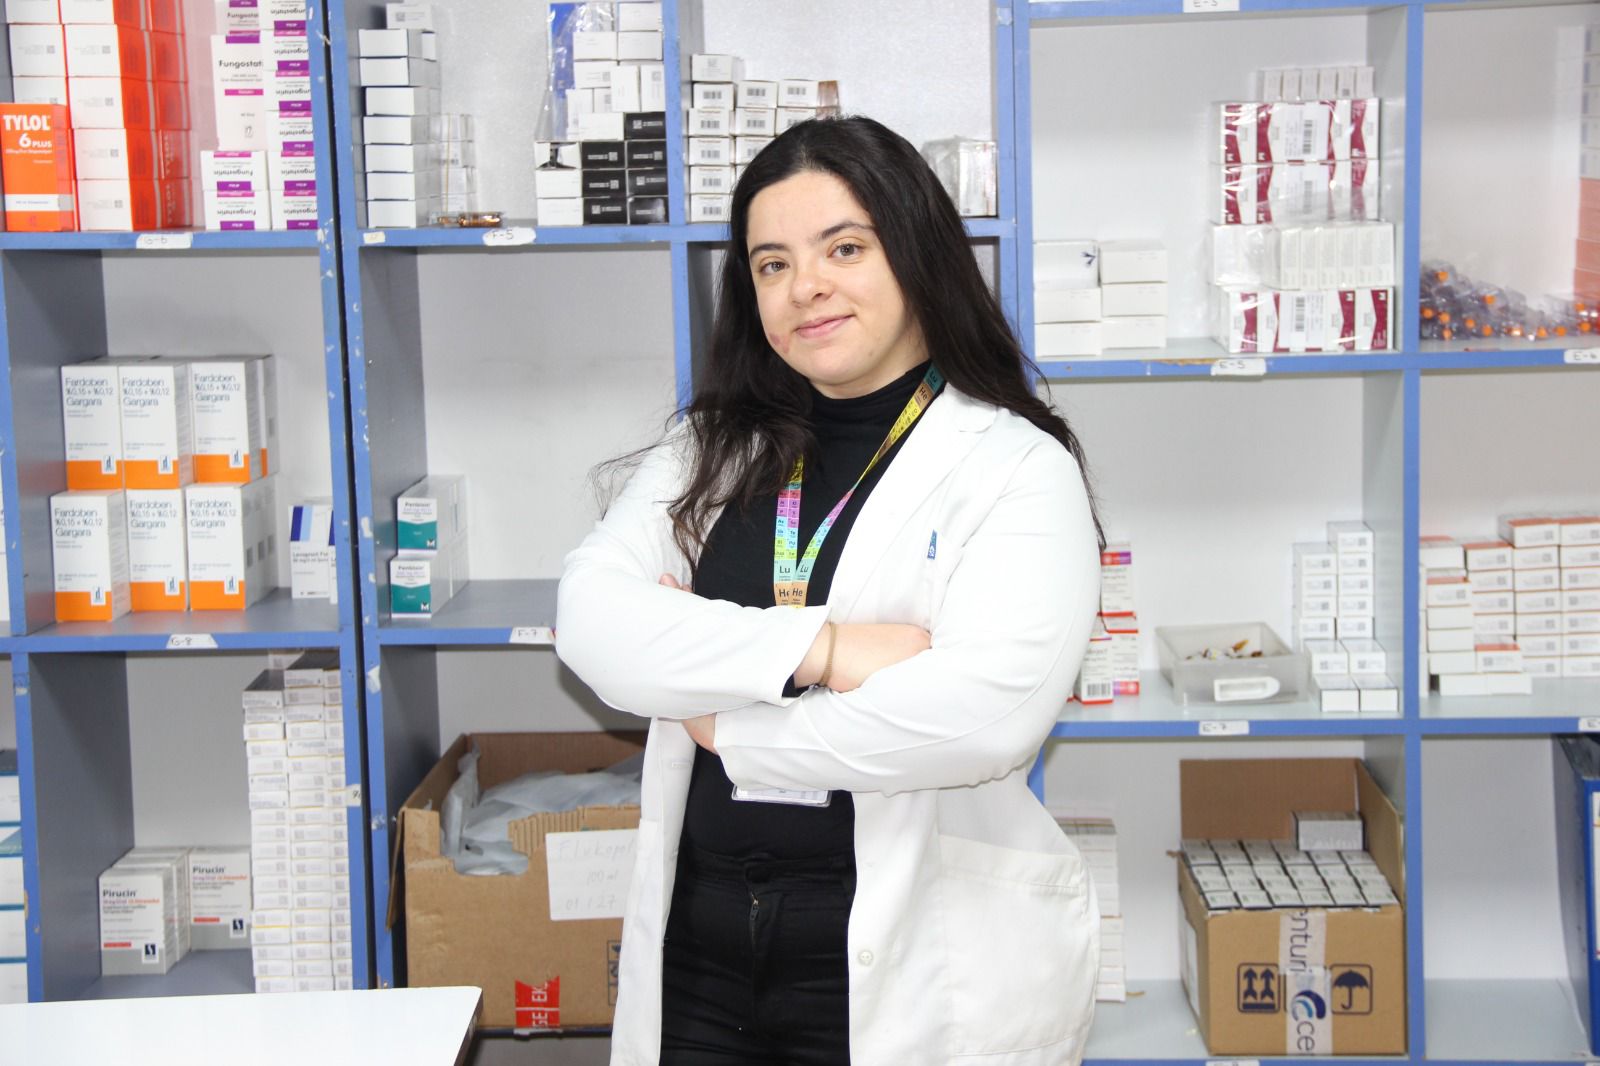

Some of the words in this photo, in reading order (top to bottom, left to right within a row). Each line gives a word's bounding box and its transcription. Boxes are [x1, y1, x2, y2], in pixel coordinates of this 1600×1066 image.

[3, 115, 51, 131] TYLOL
[19, 132, 32, 148] 6
[66, 377, 108, 386] Fardoben
[123, 377, 164, 386] Fardoben
[194, 374, 235, 382] Fardoben
[66, 397, 102, 407] Gargara
[195, 393, 230, 402] Gargara
[123, 398, 158, 407] Gargara
[130, 500, 172, 509] Fardoben
[190, 500, 231, 508] Fardoben
[55, 508, 97, 517] Fardoben
[131, 520, 166, 529] Gargara
[191, 519, 225, 528] Gargara
[56, 528, 92, 538] Gargara
[792, 588, 803, 596] He
[103, 889, 136, 897] Pirucin
